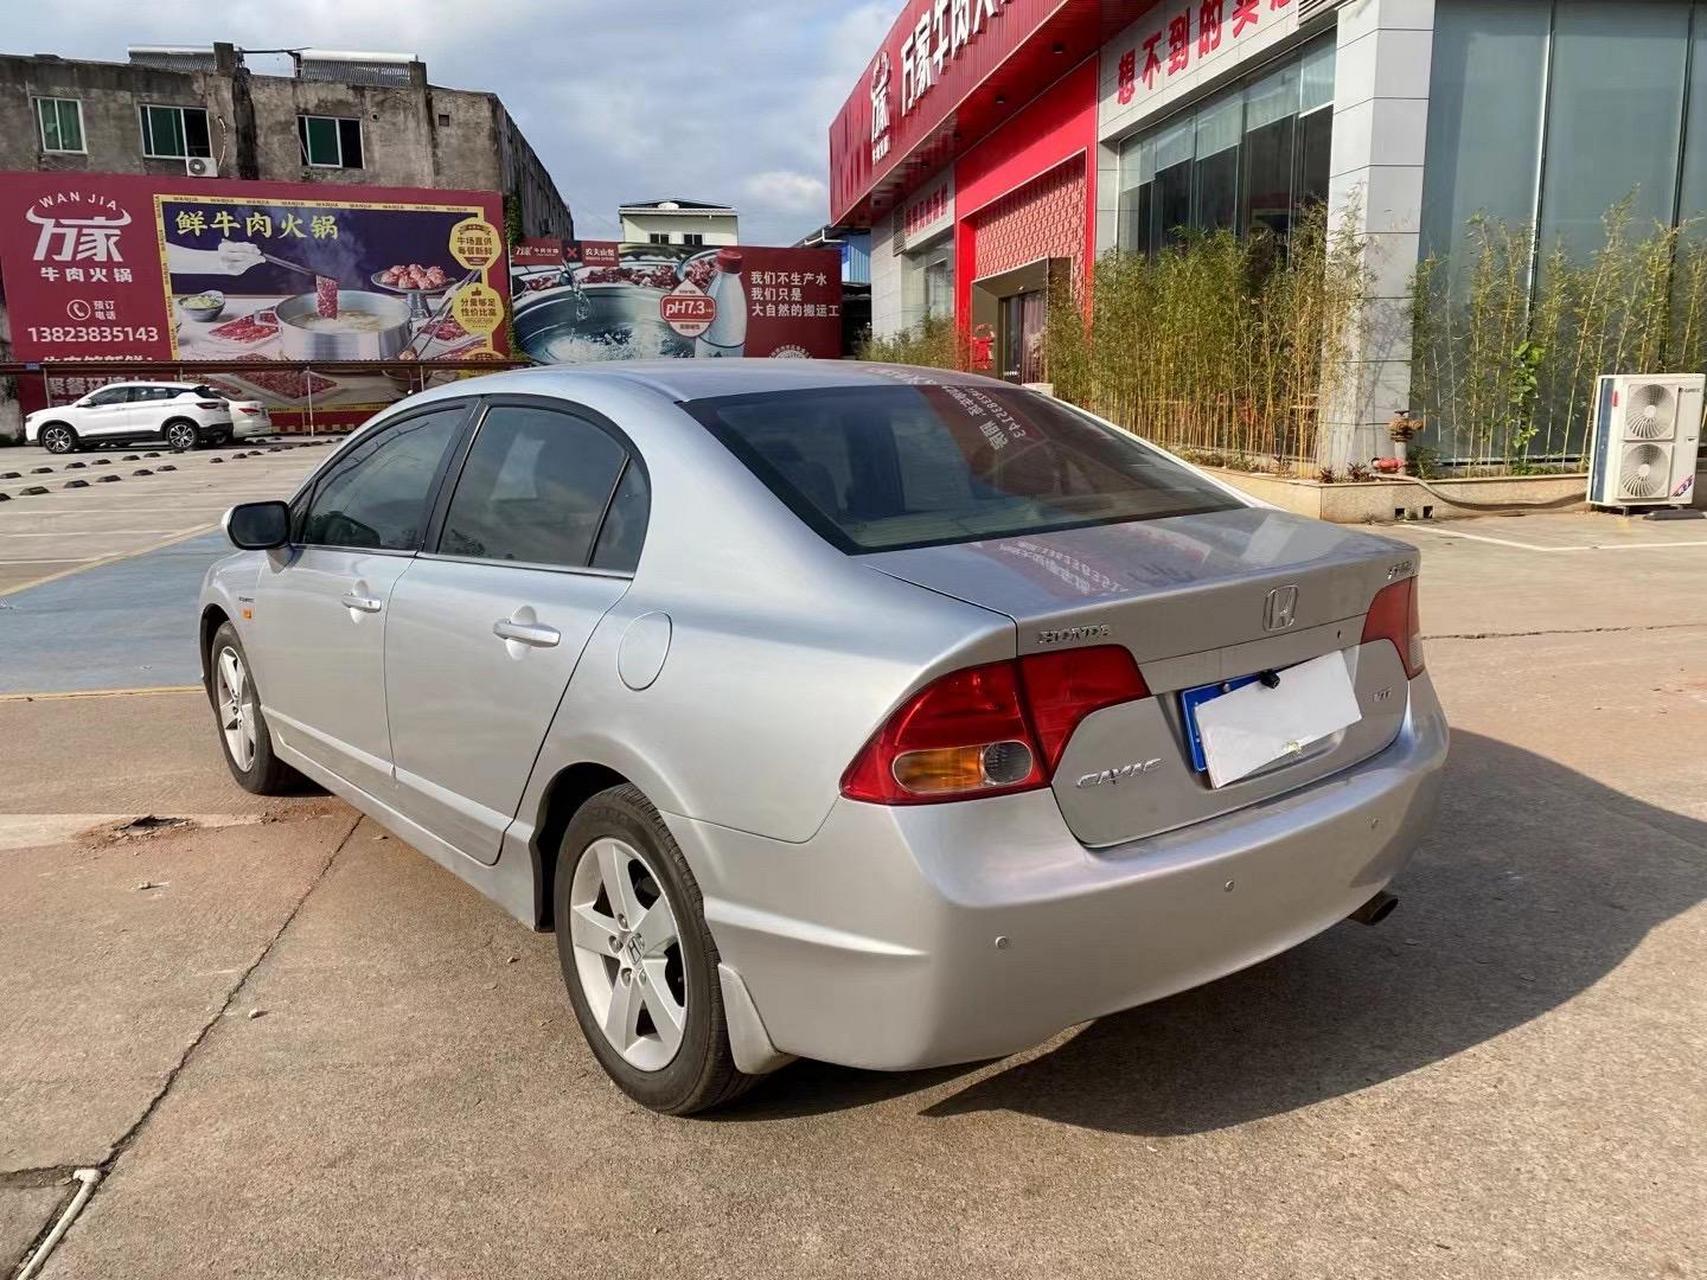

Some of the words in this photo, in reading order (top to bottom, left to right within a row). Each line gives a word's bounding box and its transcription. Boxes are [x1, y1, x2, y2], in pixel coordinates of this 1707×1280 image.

[39, 191, 81, 208] WAN
[87, 194, 117, 211] JIA
[175, 210, 339, 240] 鲜牛肉火锅
[25, 206, 132, 262] 万家
[40, 267, 133, 283] 牛肉火锅
[751, 270, 828, 286] 我们不生产水
[751, 287, 803, 301] 我们只是
[752, 302, 840, 317] 大自然的搬运工
[27, 327, 159, 343] 13823835143
